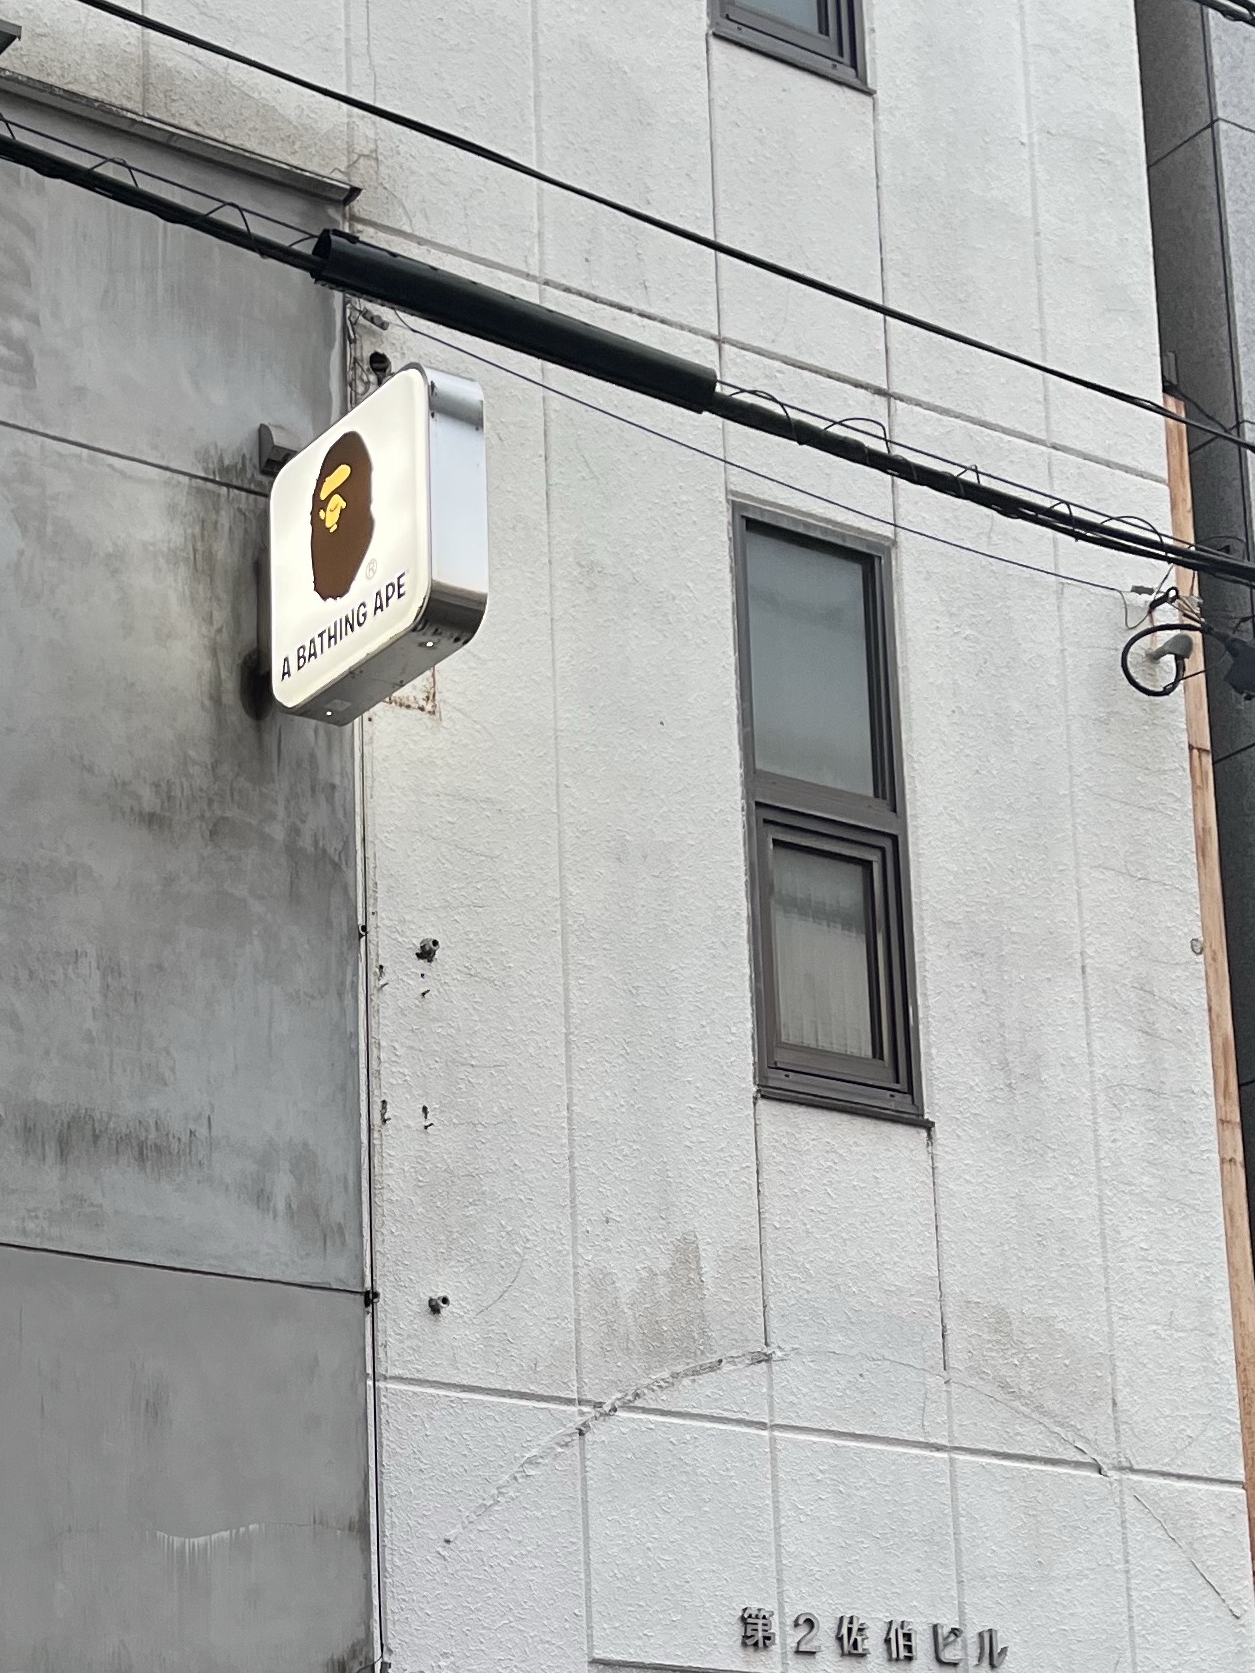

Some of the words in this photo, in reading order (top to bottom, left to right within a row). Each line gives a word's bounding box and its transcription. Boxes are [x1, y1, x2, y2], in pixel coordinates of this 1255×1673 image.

[281, 655, 292, 682] A
[296, 602, 368, 672] BATHING
[373, 571, 407, 617] APE
[741, 1606, 1009, 1669] 第2佐伯ビル
